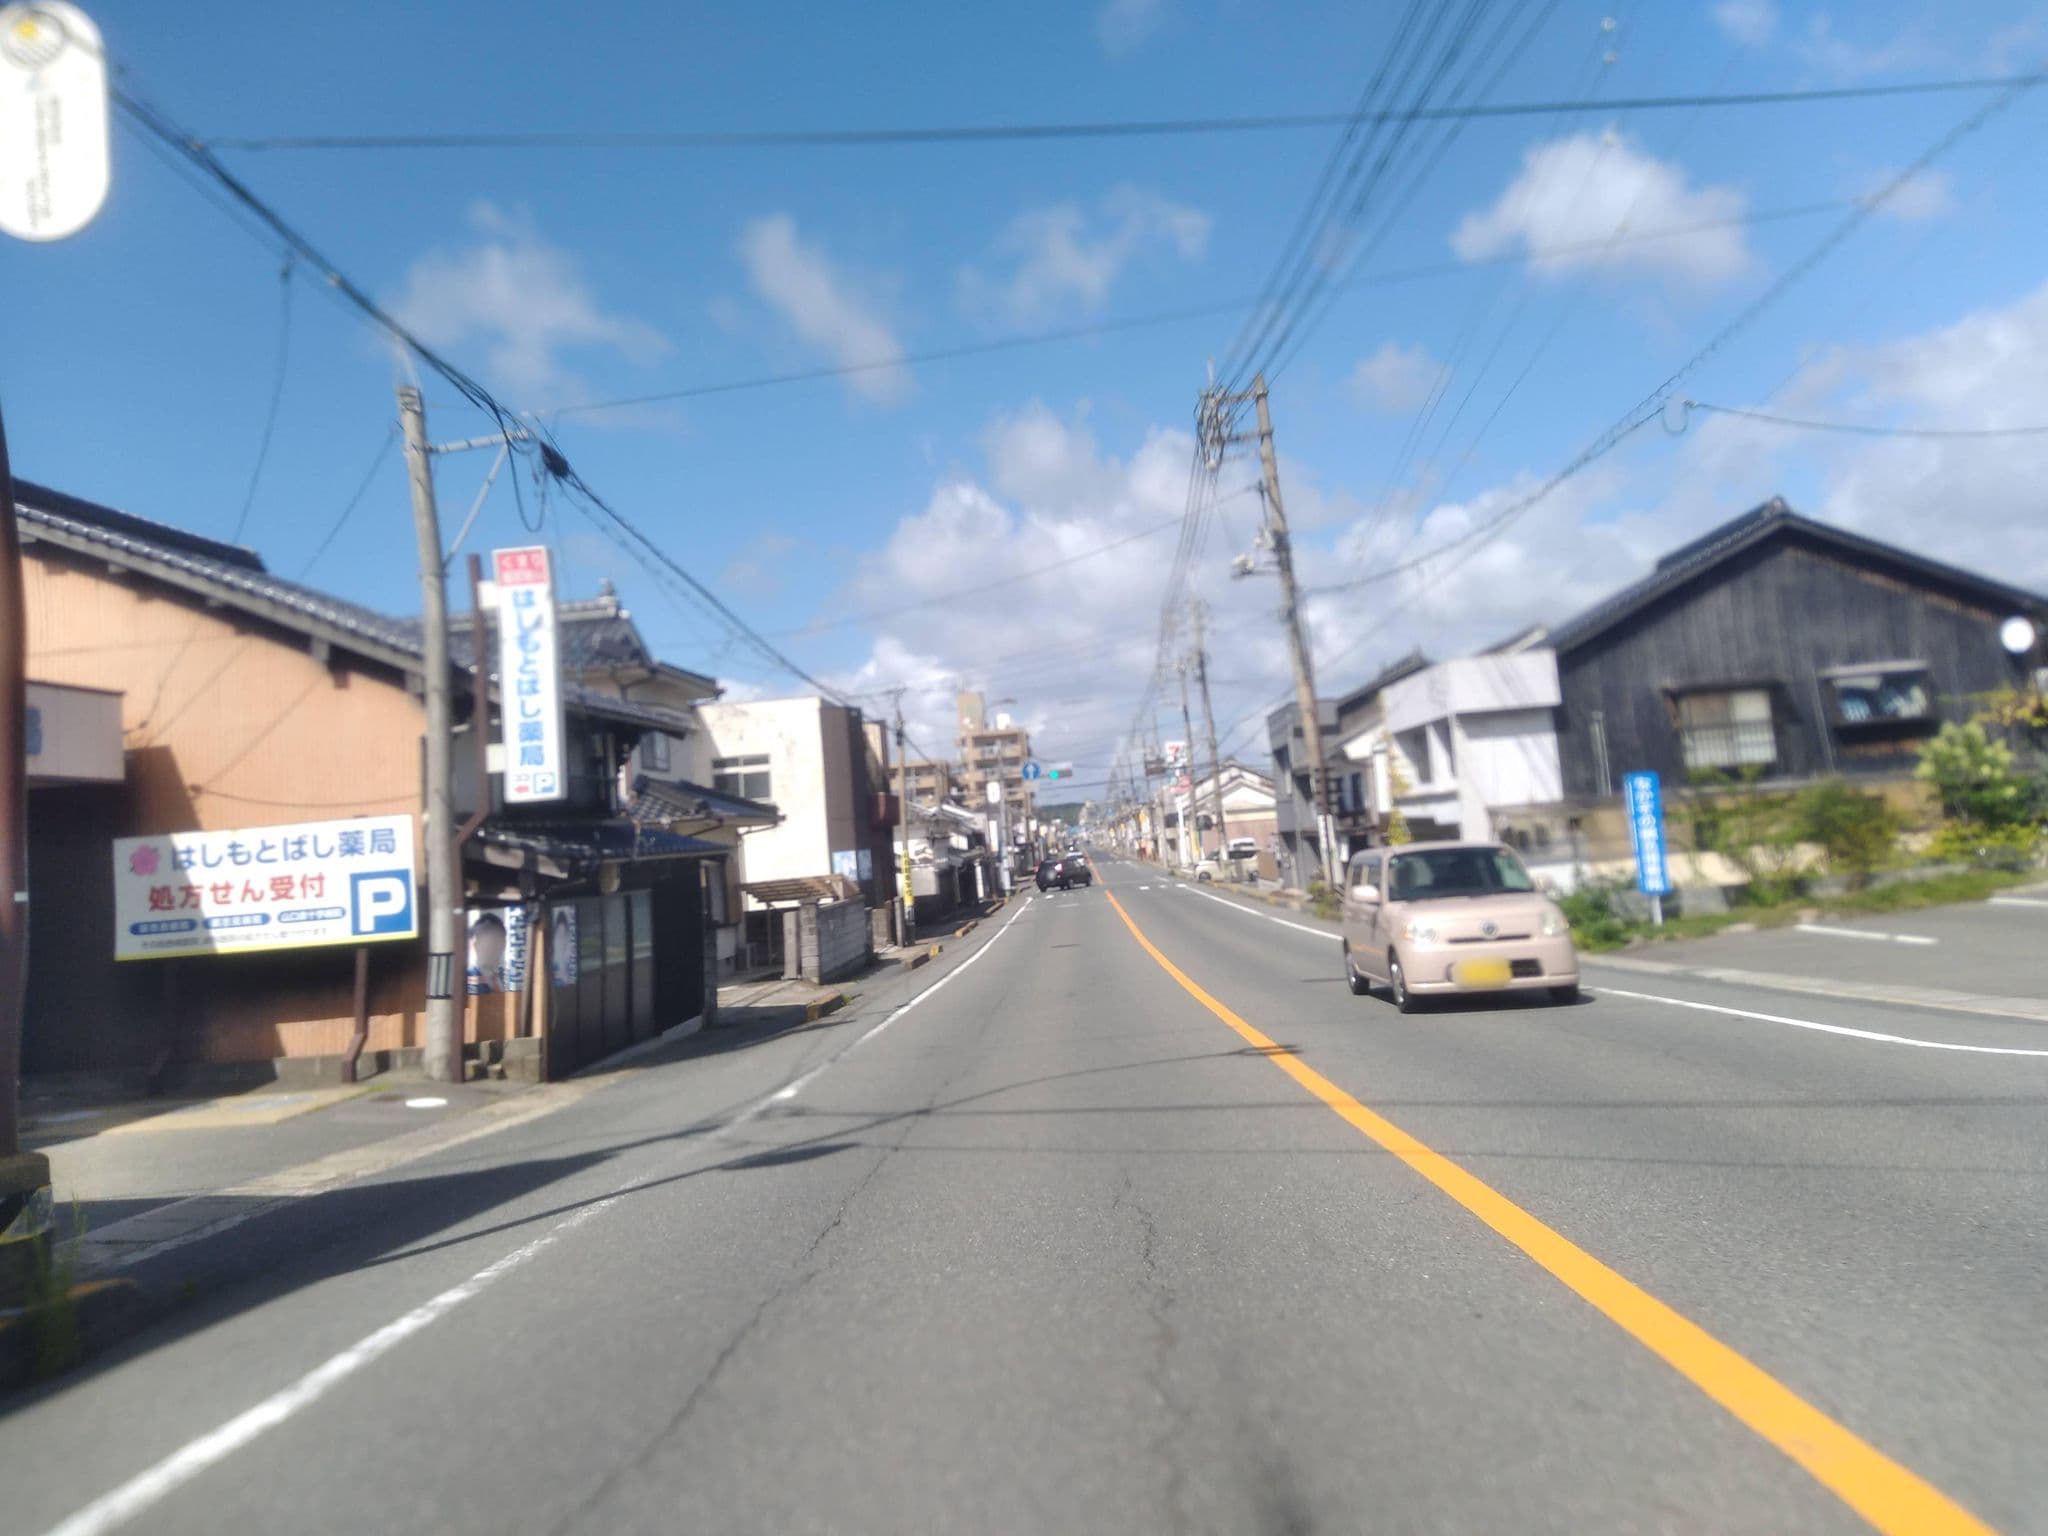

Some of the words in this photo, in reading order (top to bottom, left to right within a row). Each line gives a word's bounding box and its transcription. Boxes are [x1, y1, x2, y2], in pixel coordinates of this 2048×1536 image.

[171, 827, 397, 872] はしもとばし薬局
[147, 872, 326, 912] 処方せん受付
[357, 876, 407, 933] P
